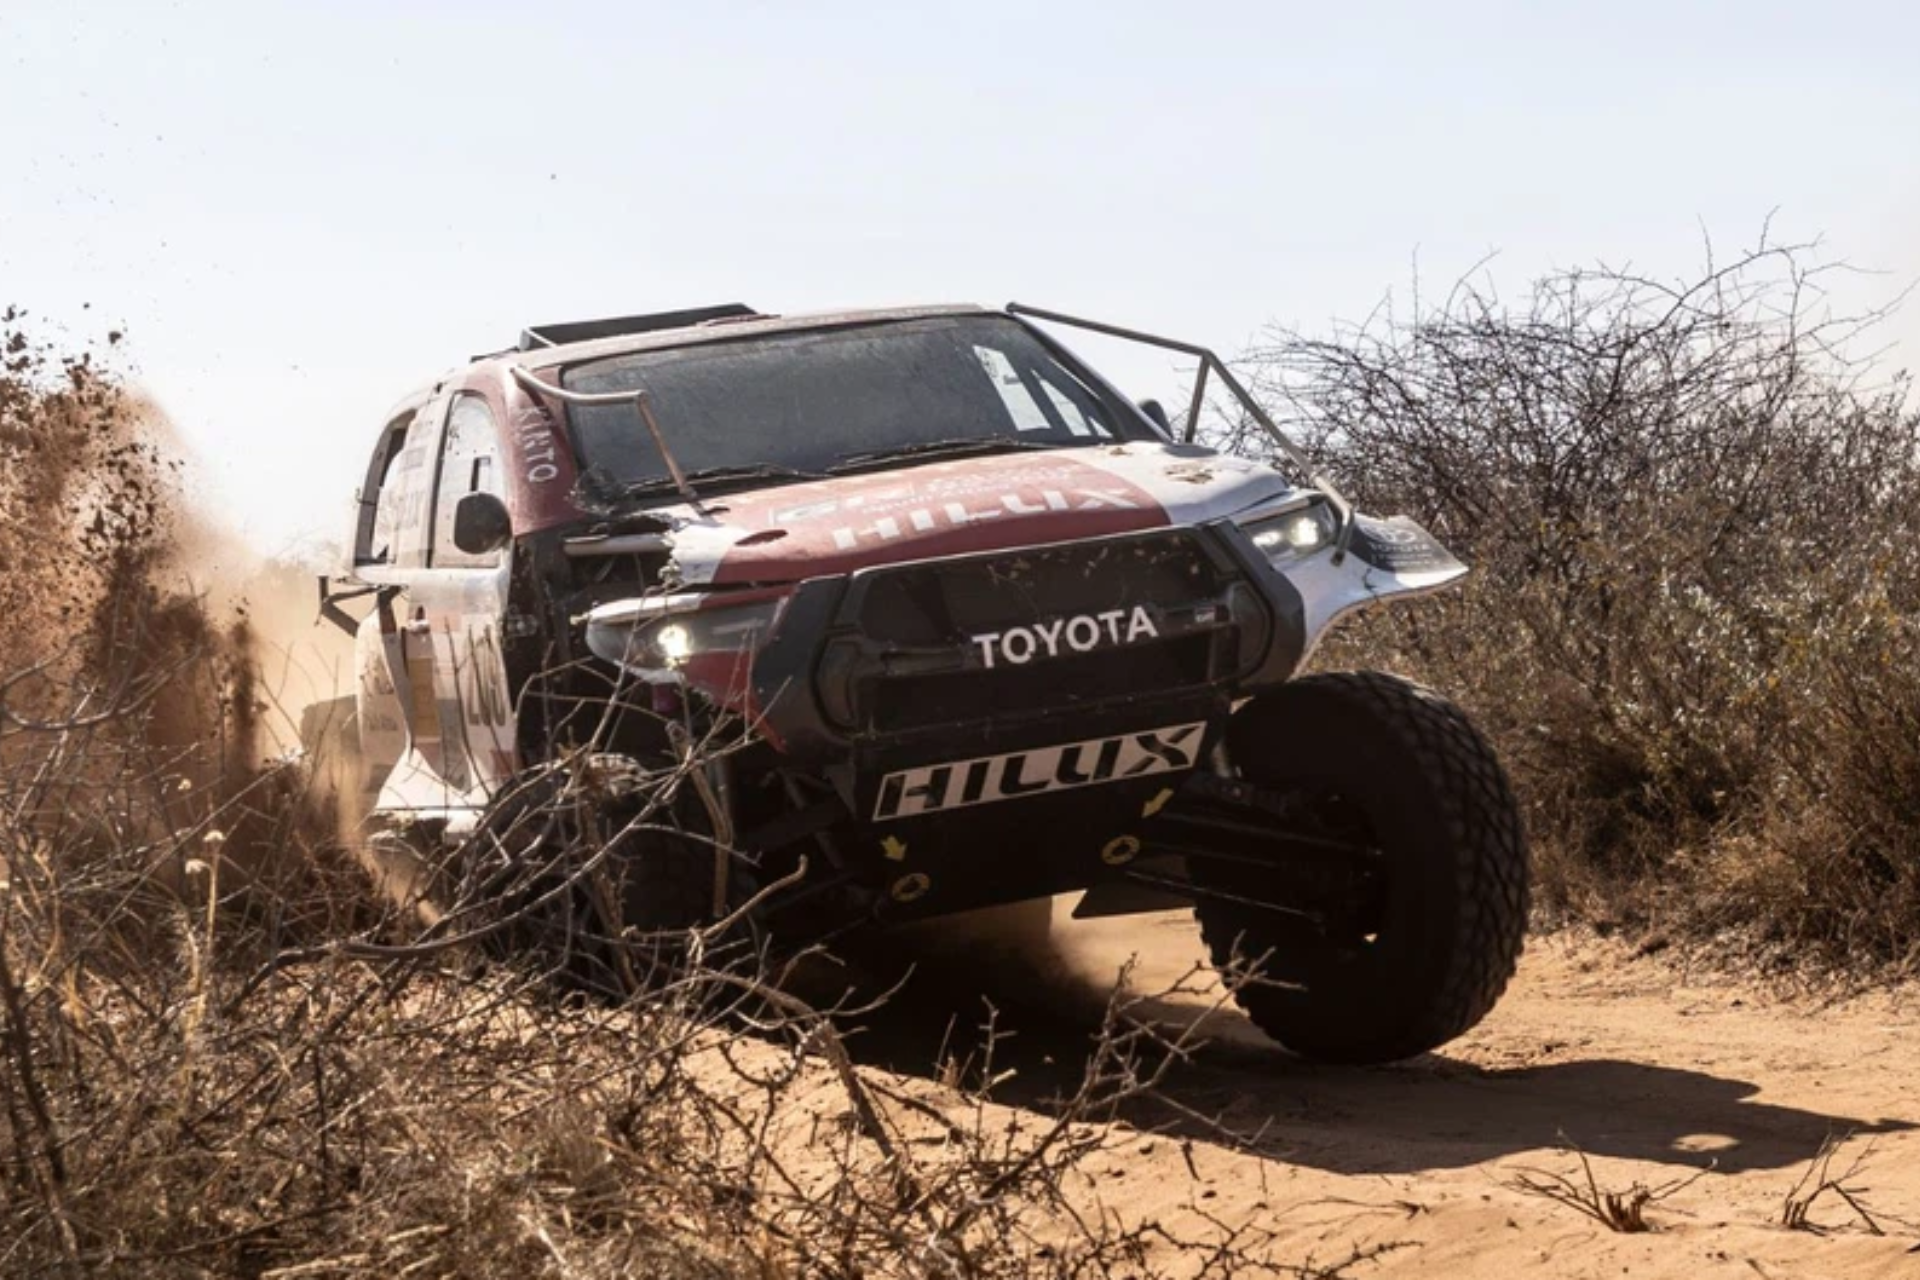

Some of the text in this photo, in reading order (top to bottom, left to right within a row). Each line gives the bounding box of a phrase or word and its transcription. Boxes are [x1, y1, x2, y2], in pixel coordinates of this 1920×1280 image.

[832, 487, 1140, 550] HILUX
[972, 605, 1159, 669] TOYOTA
[878, 726, 1200, 818] HILUX
